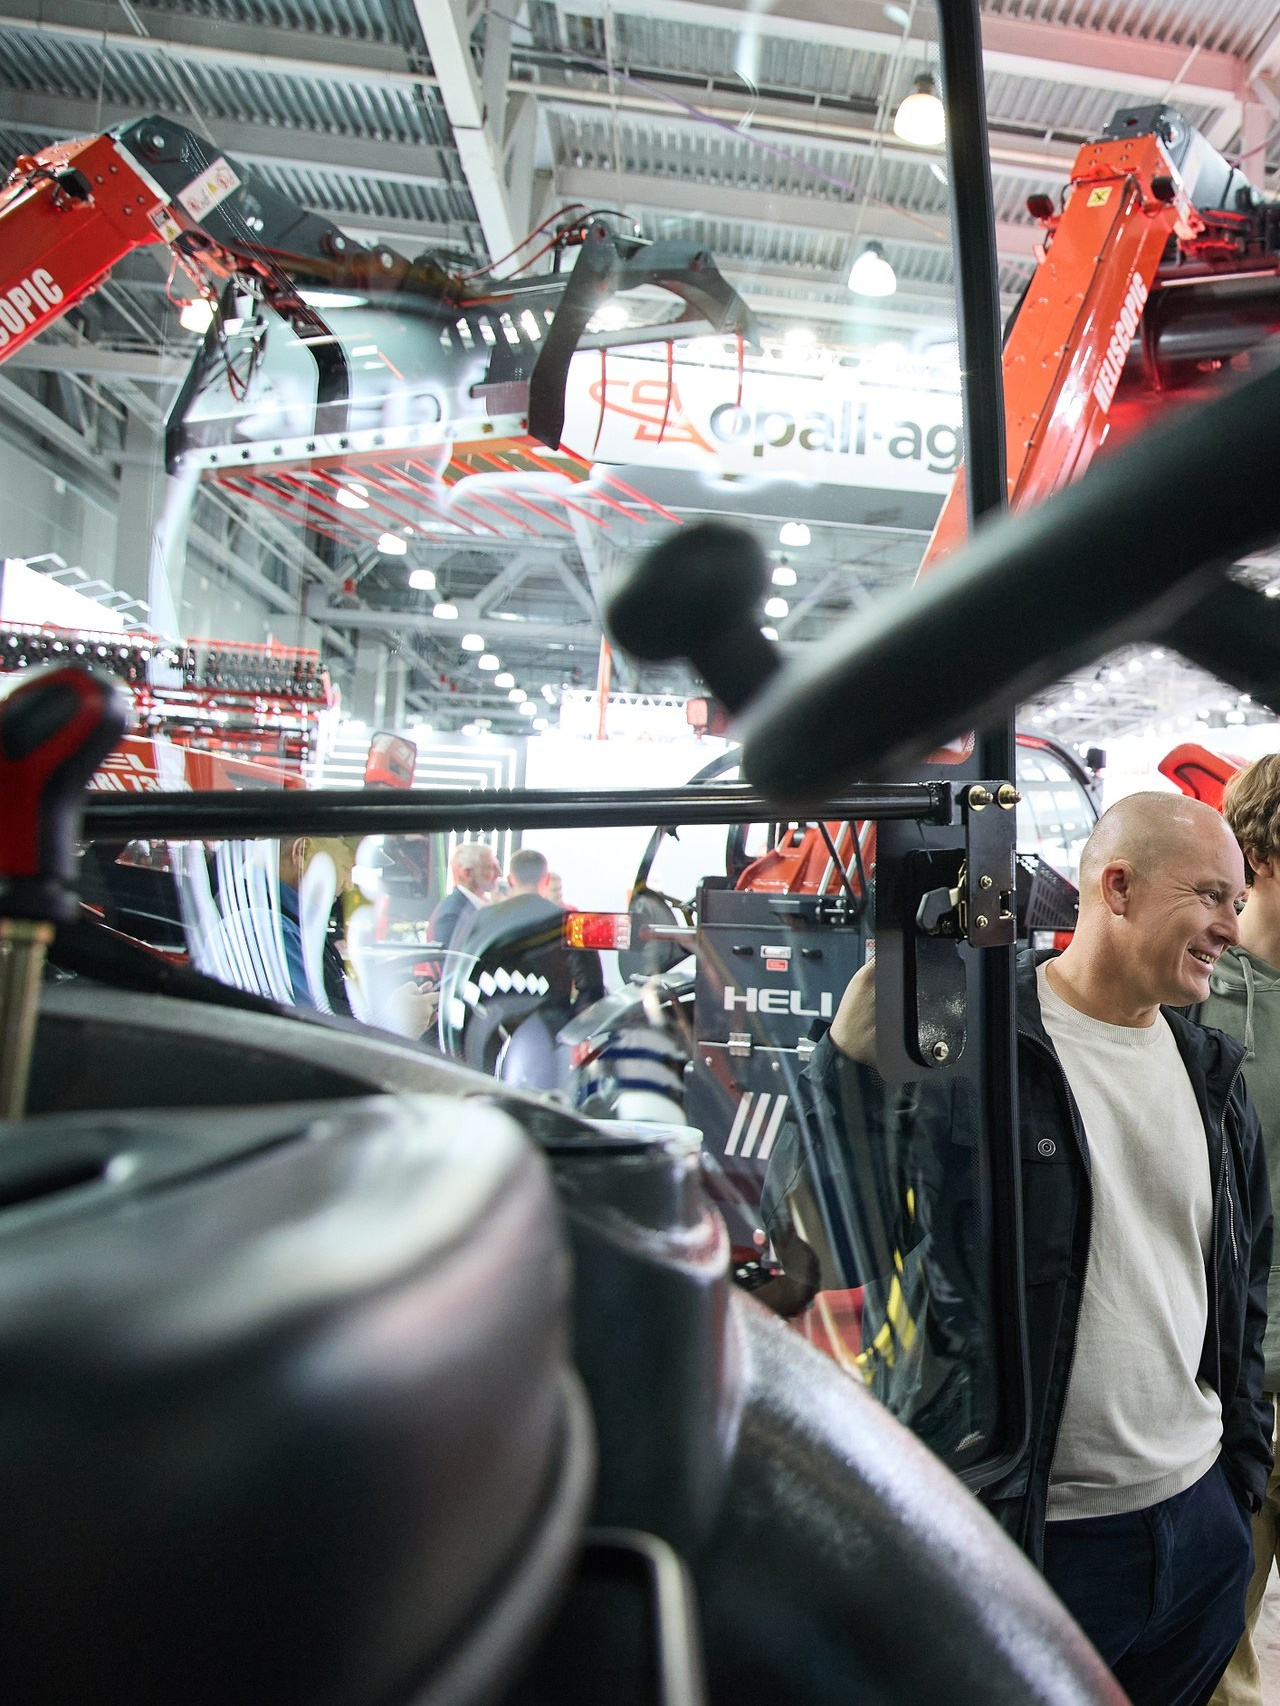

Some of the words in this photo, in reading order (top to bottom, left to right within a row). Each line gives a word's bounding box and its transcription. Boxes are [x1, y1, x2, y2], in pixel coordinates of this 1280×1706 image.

[0, 268, 64, 348] OPIC
[1093, 271, 1148, 415] HELISCOPIC
[723, 985, 833, 1018] HELI
